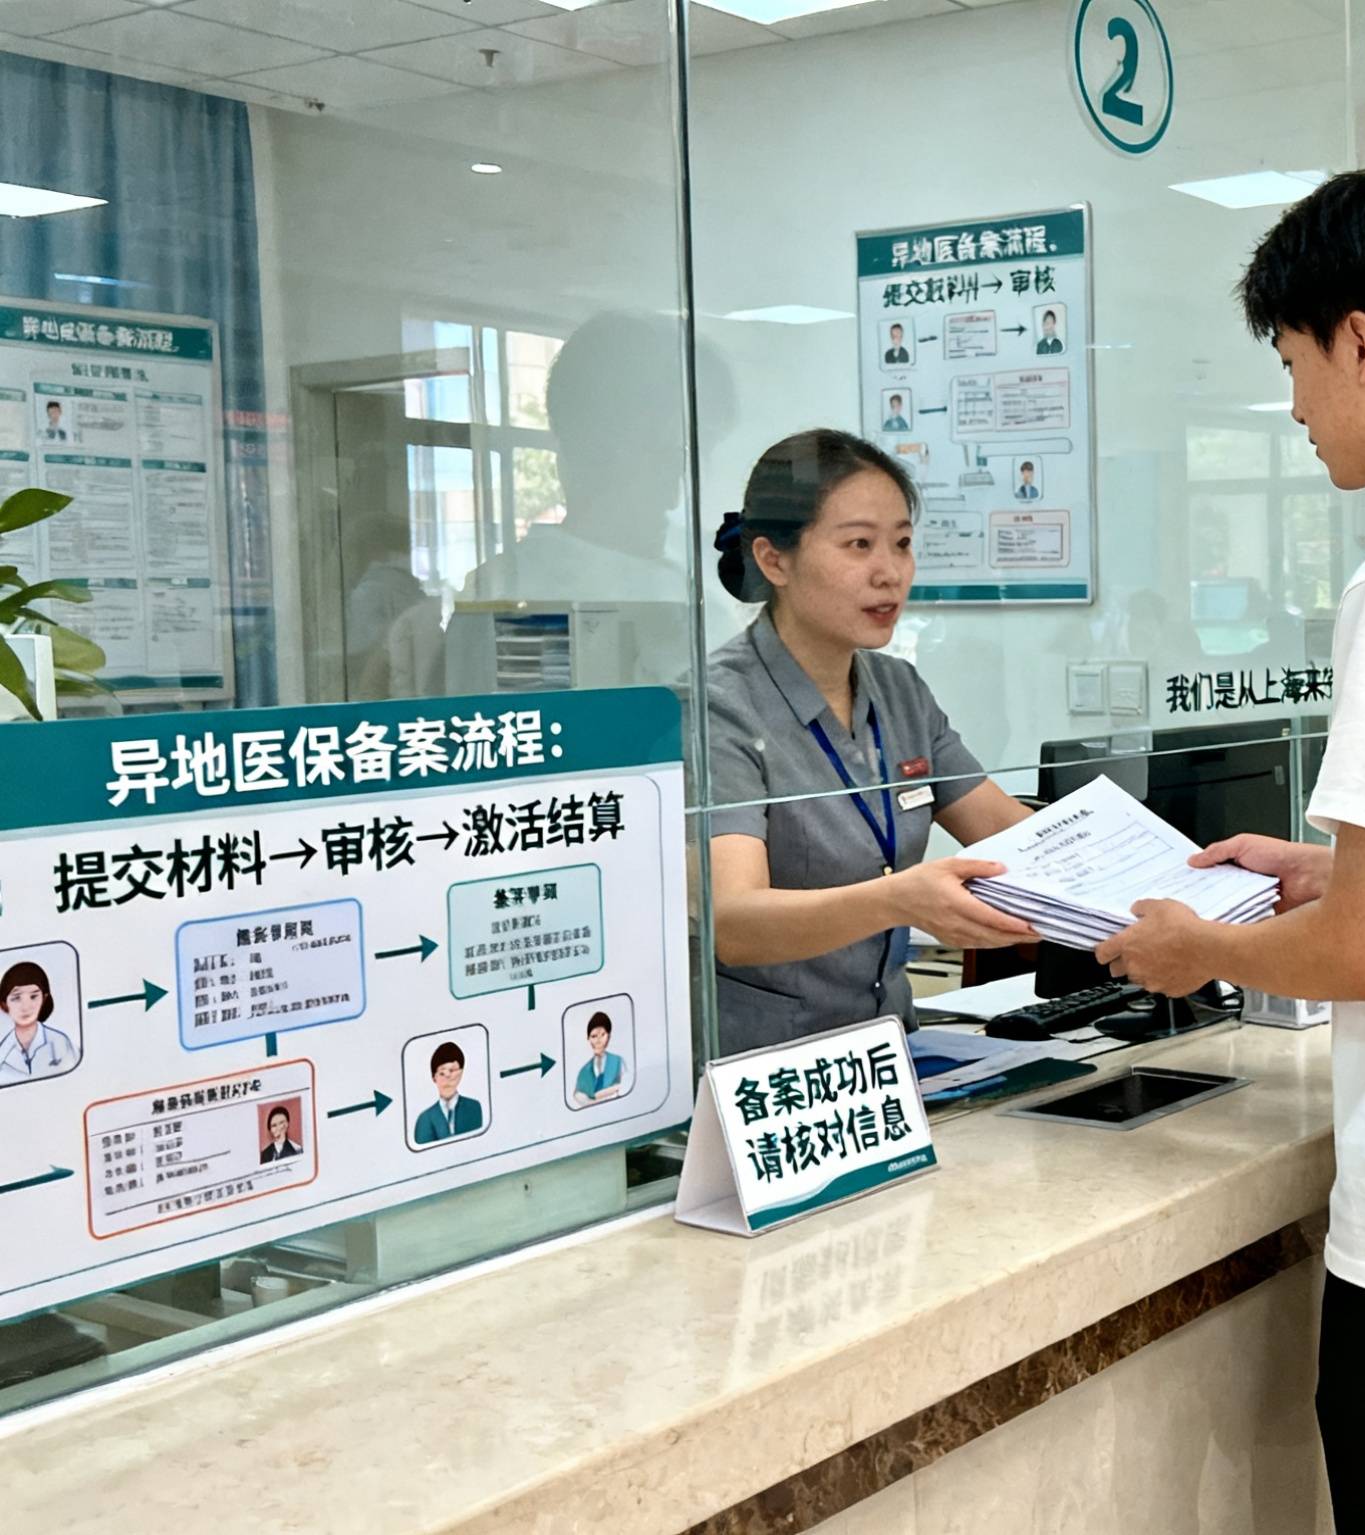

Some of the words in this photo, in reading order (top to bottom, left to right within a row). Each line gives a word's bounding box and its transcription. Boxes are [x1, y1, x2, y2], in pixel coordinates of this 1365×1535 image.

[1102, 16, 1143, 126] 2
[106, 709, 564, 806] 异地医保备案流程：
[53, 829, 267, 914] 提交材料
[321, 815, 416, 876] 审核
[462, 790, 626, 858] 激活结算
[734, 1042, 899, 1126] 备案成功后
[746, 1094, 912, 1183] 请核对信息
